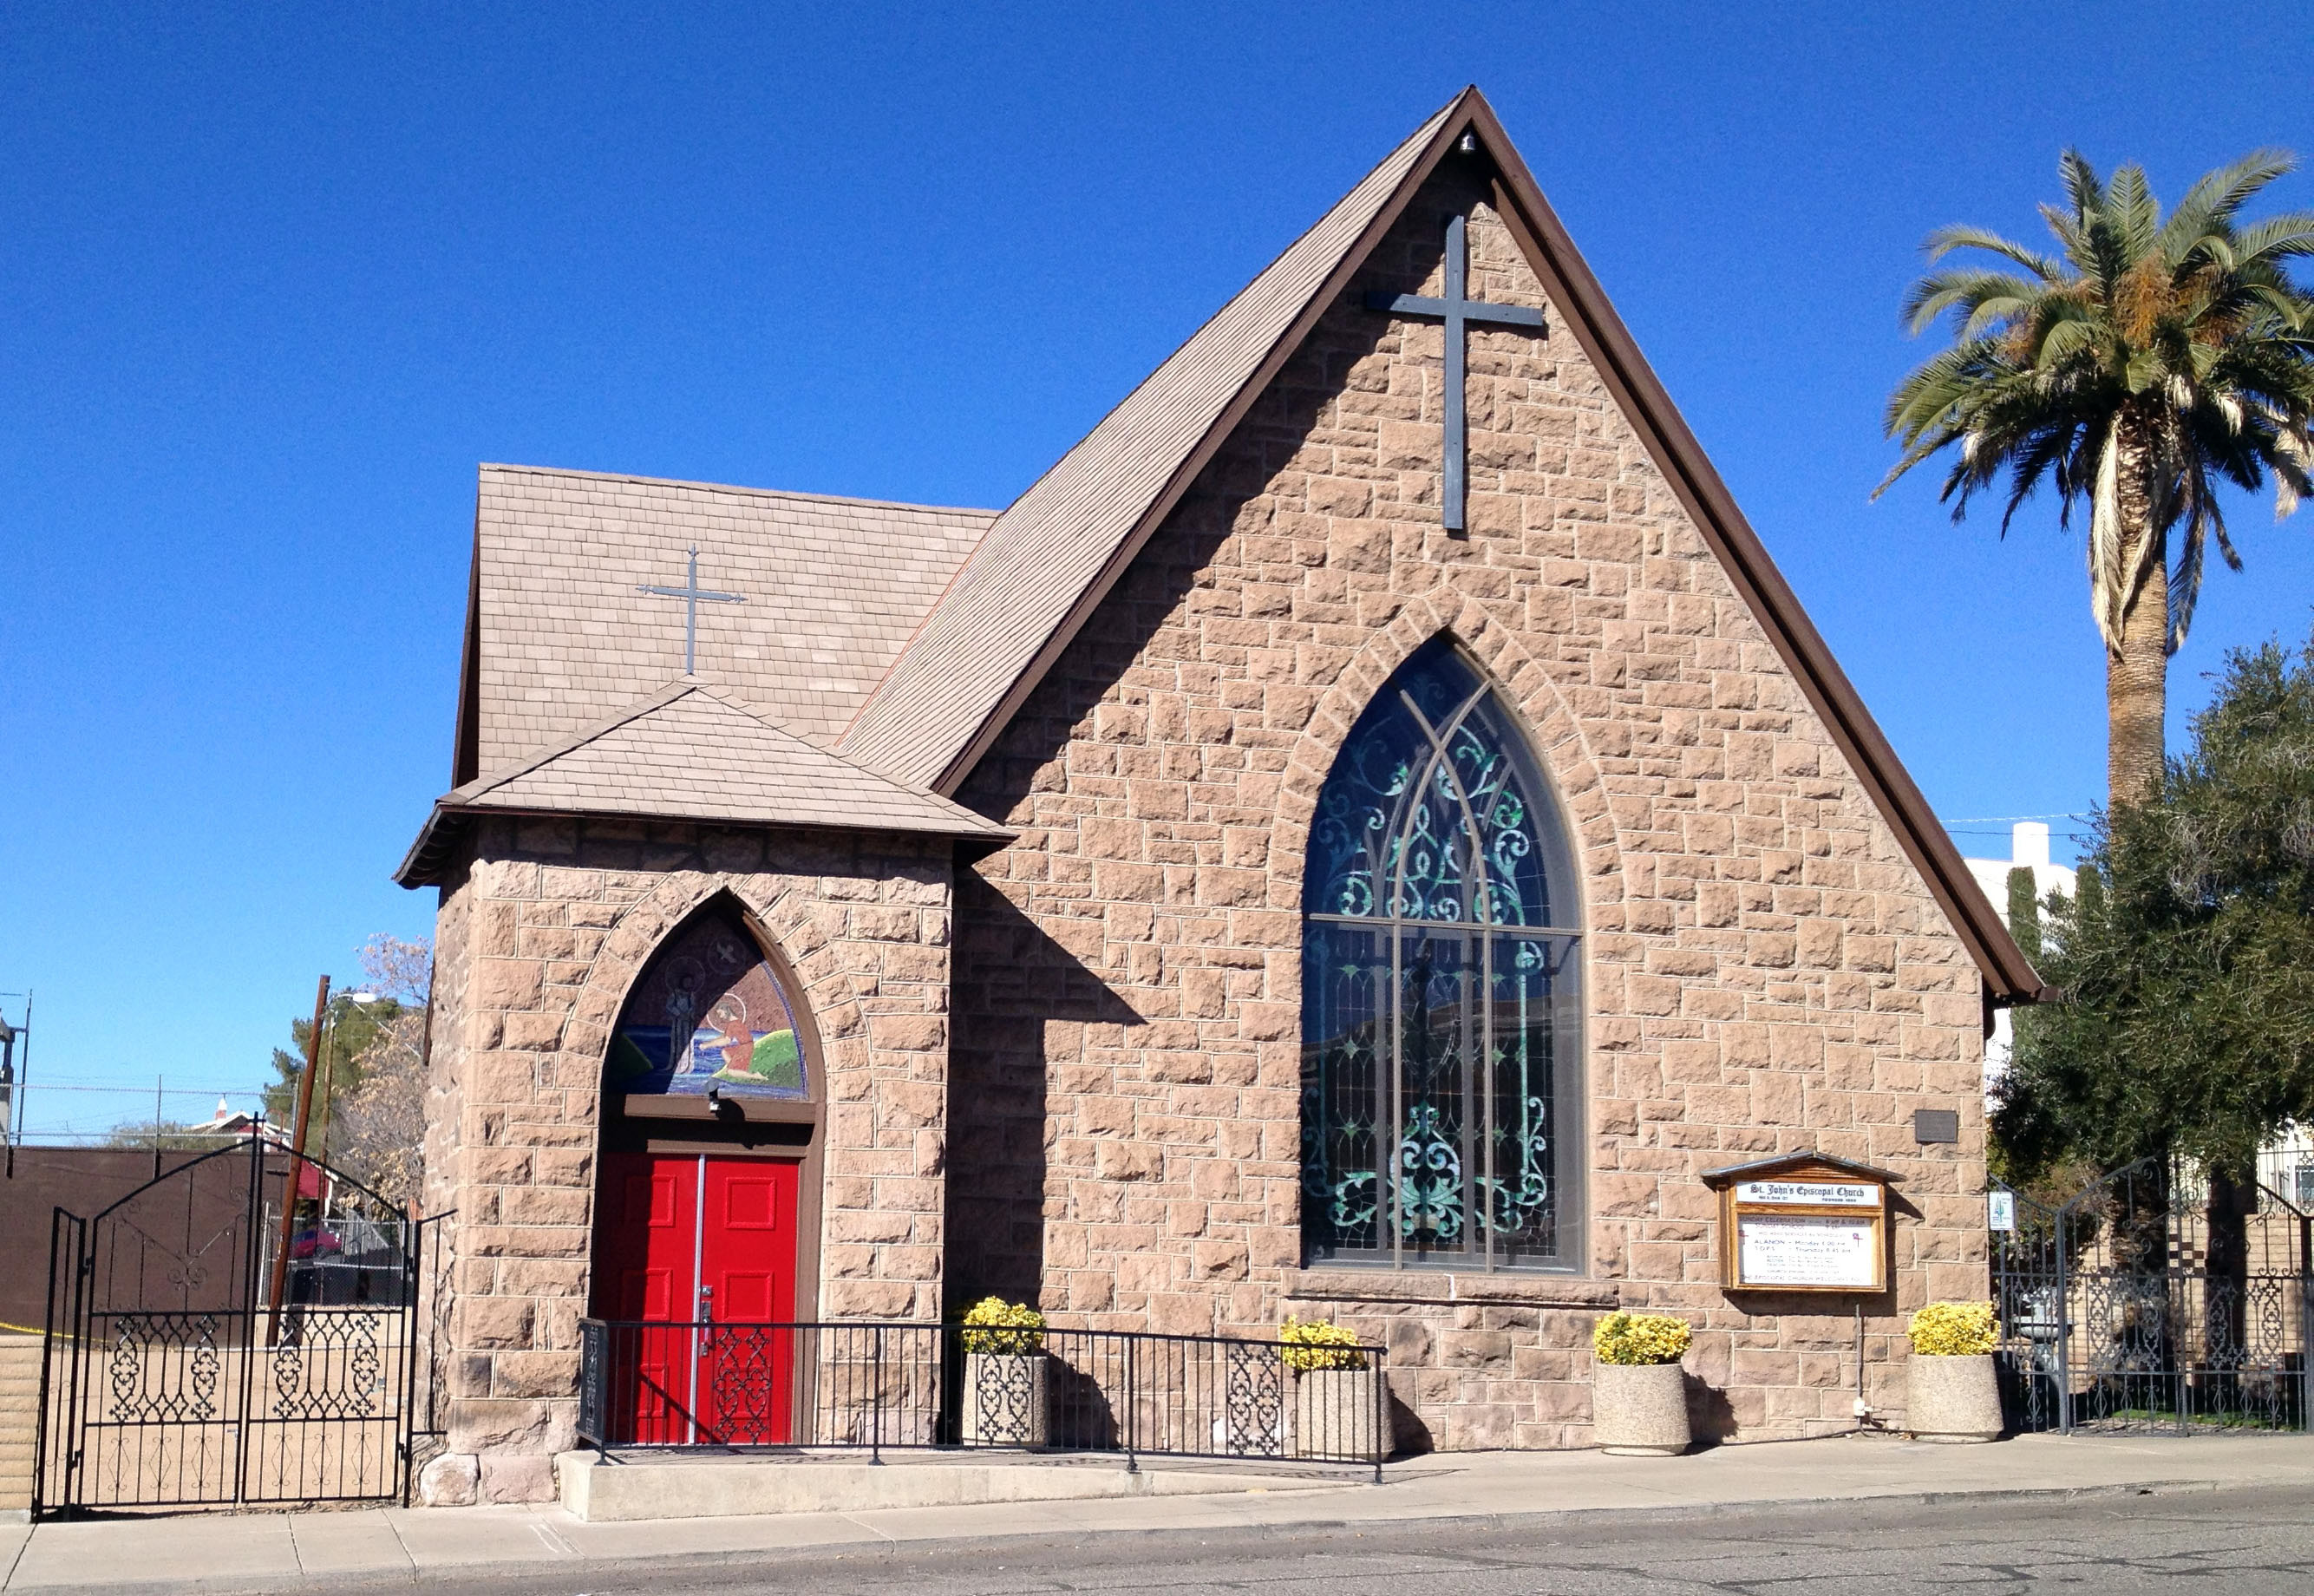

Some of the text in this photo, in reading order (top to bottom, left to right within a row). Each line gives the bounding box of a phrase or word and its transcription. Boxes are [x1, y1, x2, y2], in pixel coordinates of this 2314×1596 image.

[1750, 1184, 1864, 1197] St. John's Episcopal Church
